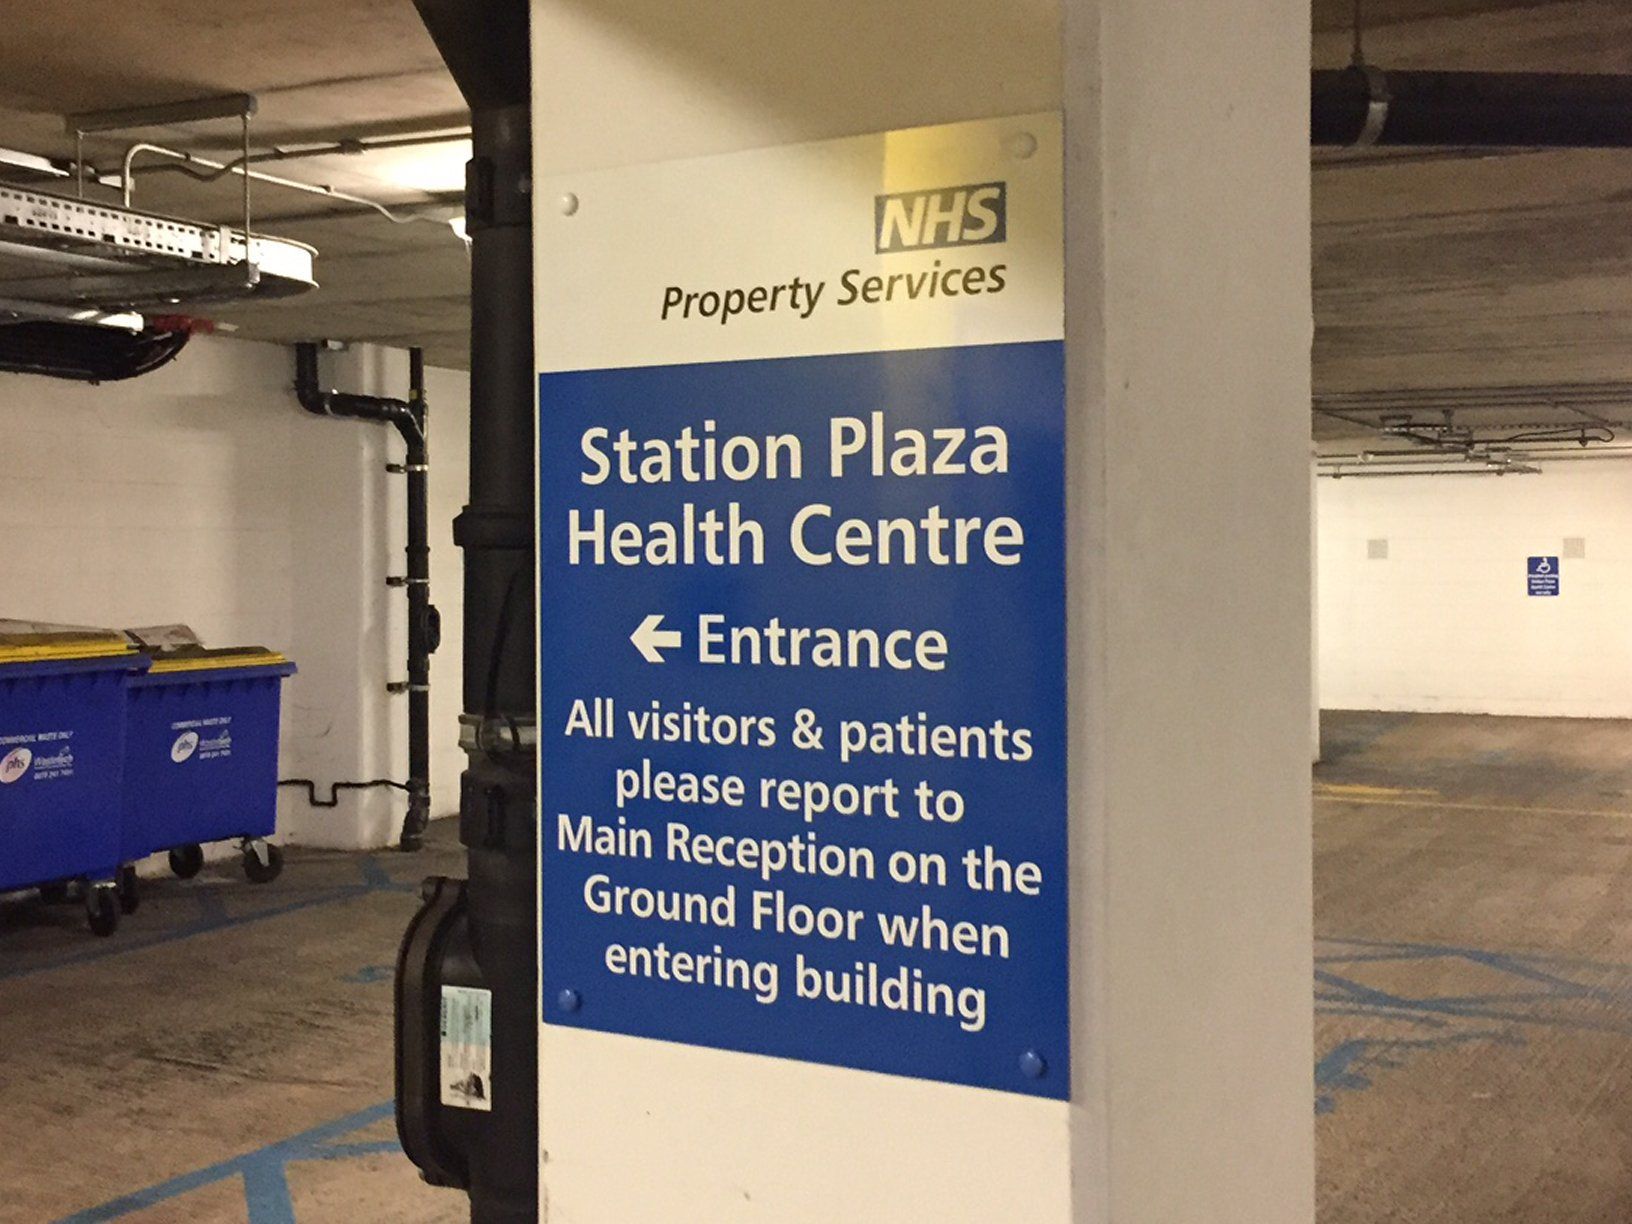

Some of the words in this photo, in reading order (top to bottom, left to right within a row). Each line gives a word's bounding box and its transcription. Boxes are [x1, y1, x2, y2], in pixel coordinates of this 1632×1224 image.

[877, 186, 1002, 250] NHS
[661, 276, 825, 325] Property
[837, 260, 1007, 306] Services
[580, 419, 802, 486] Station
[830, 410, 1009, 478] Plaza
[568, 501, 765, 566] Health
[790, 504, 1025, 566] Centre
[698, 613, 949, 672] Entrance
[564, 696, 614, 739] All
[627, 699, 777, 748] visitors
[792, 708, 825, 750] &
[840, 712, 1033, 763] patients
[616, 758, 745, 809] please
[760, 777, 900, 823] report
[913, 780, 965, 823] to
[557, 813, 652, 859] Main
[666, 822, 875, 882] Reception
[888, 850, 947, 887] on
[961, 845, 1043, 896] the
[583, 873, 736, 928] Ground
[752, 884, 865, 941] Floor
[877, 904, 1010, 959] when
[605, 942, 779, 1005] entering
[795, 953, 986, 1032] building
